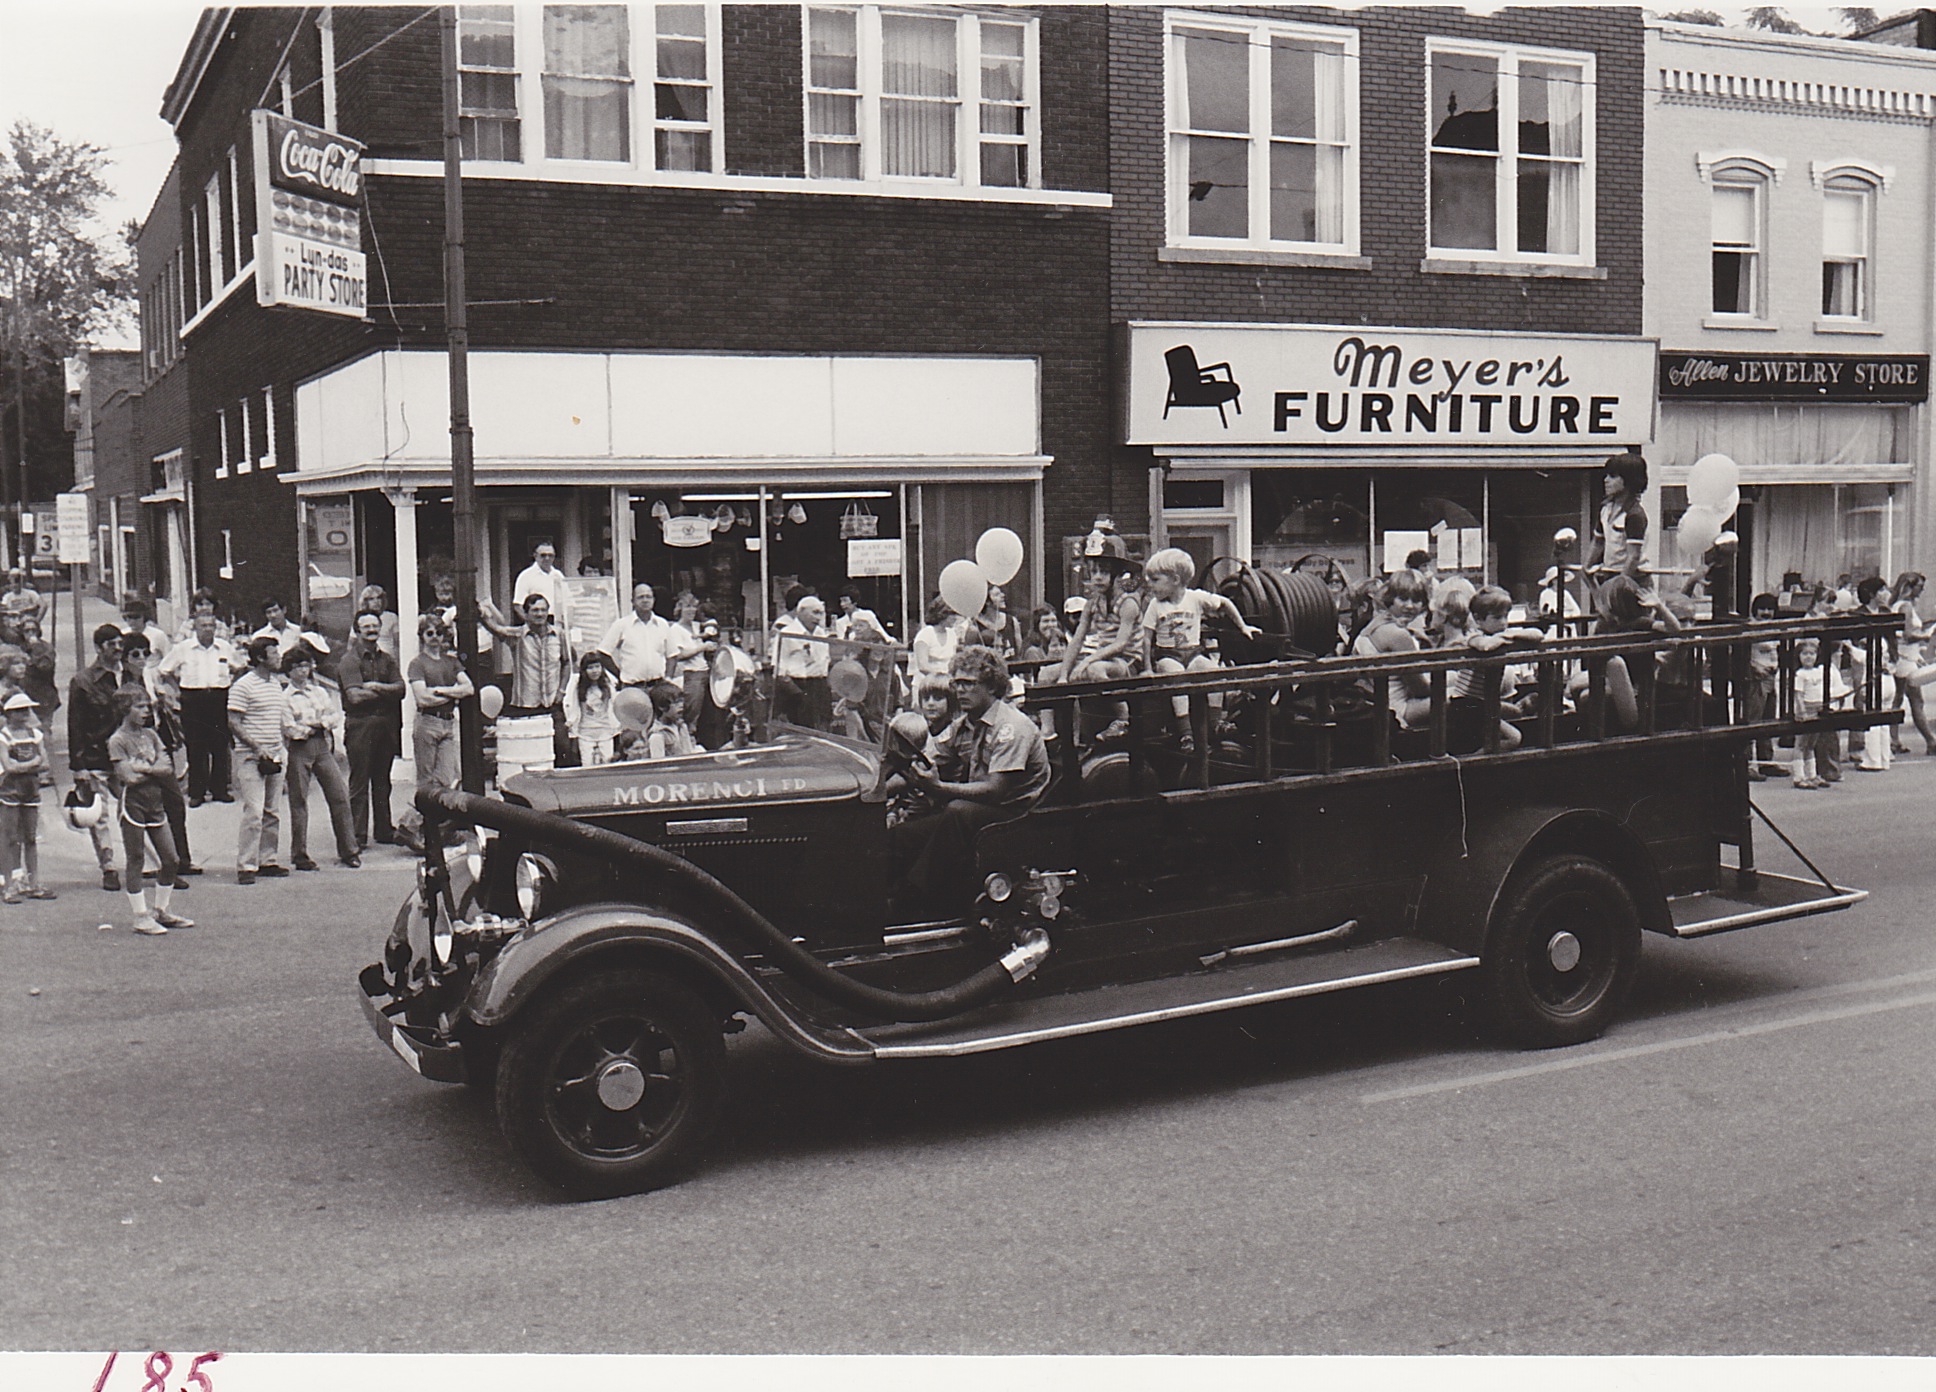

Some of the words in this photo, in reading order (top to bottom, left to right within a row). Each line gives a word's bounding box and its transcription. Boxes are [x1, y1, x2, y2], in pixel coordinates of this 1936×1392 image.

[284, 263, 325, 301] PARTY
[329, 273, 365, 309] STORE
[1333, 336, 1570, 403] Meyer's
[1668, 358, 1729, 387] Allen
[1734, 361, 1844, 383] JEWELRY
[1854, 363, 1919, 385] STORE
[1273, 391, 1620, 434] FURNITURE
[41, 534, 59, 552] 3
[612, 778, 768, 806] MORENCI
[781, 778, 807, 790] FD
